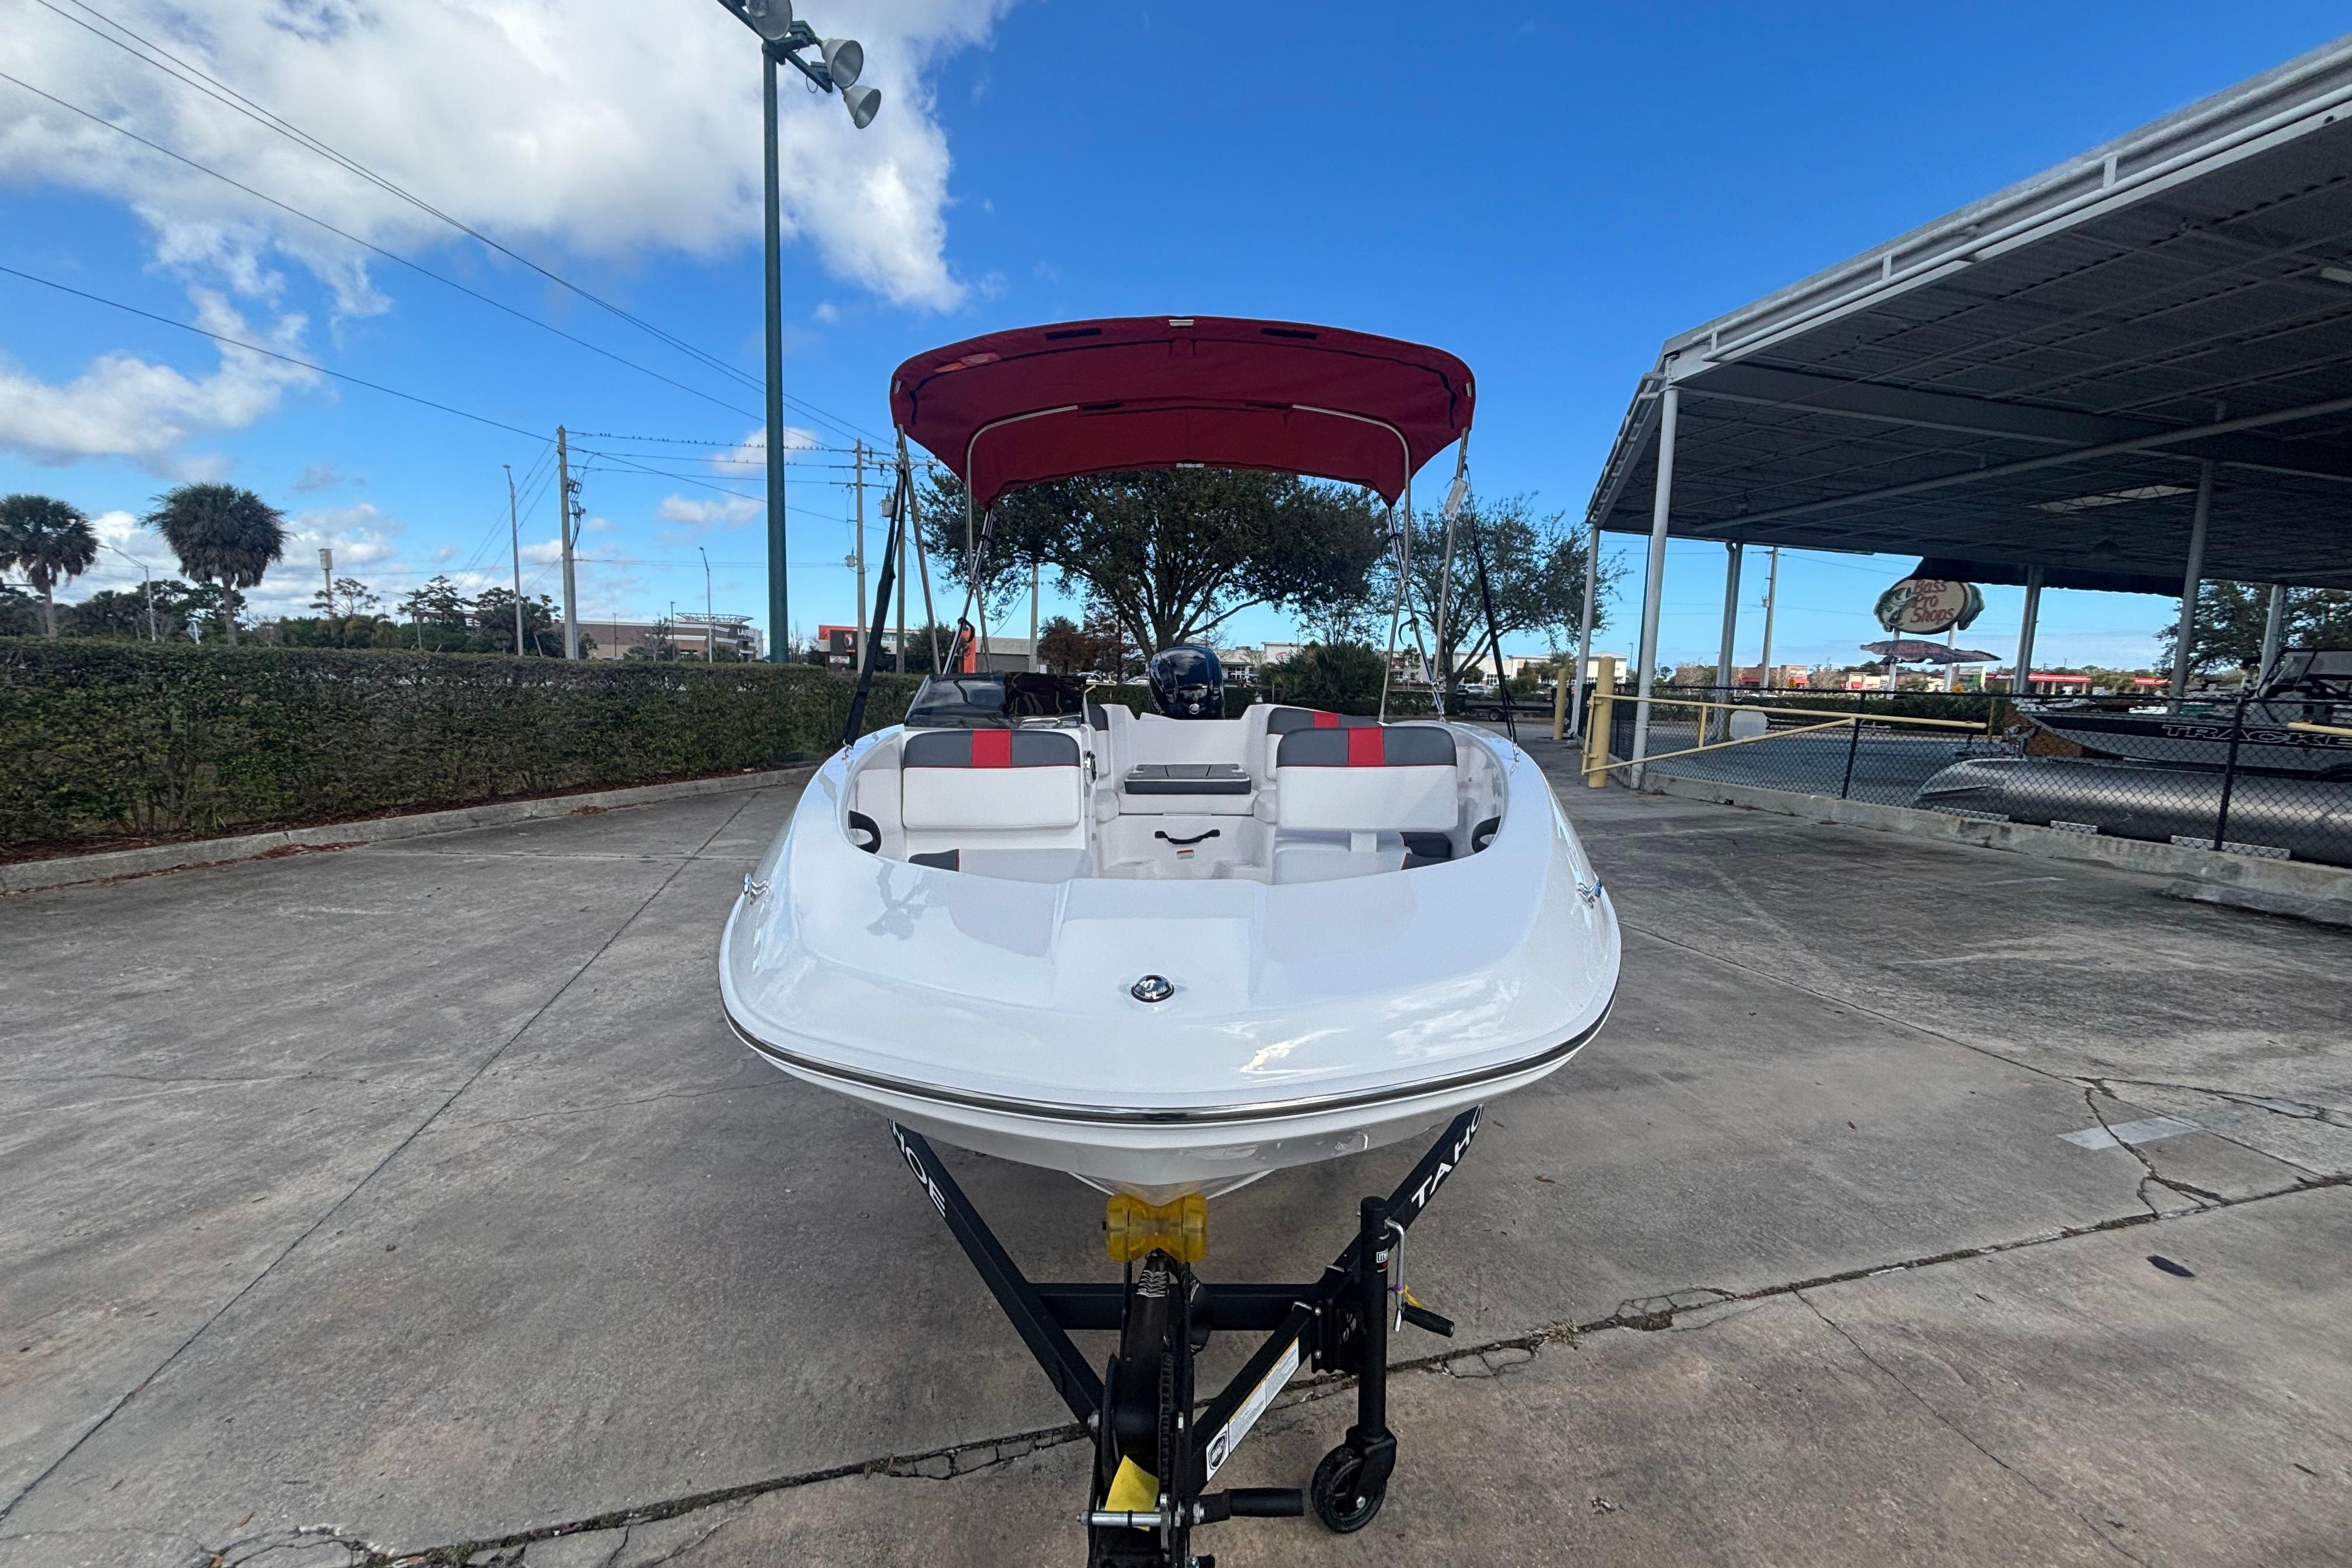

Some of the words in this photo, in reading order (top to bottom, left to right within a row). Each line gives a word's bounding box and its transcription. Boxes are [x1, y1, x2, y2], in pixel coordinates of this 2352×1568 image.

[1910, 608, 1954, 625] Shops
[889, 1118, 946, 1218] HOE
[1411, 1102, 1485, 1209] TAHO
